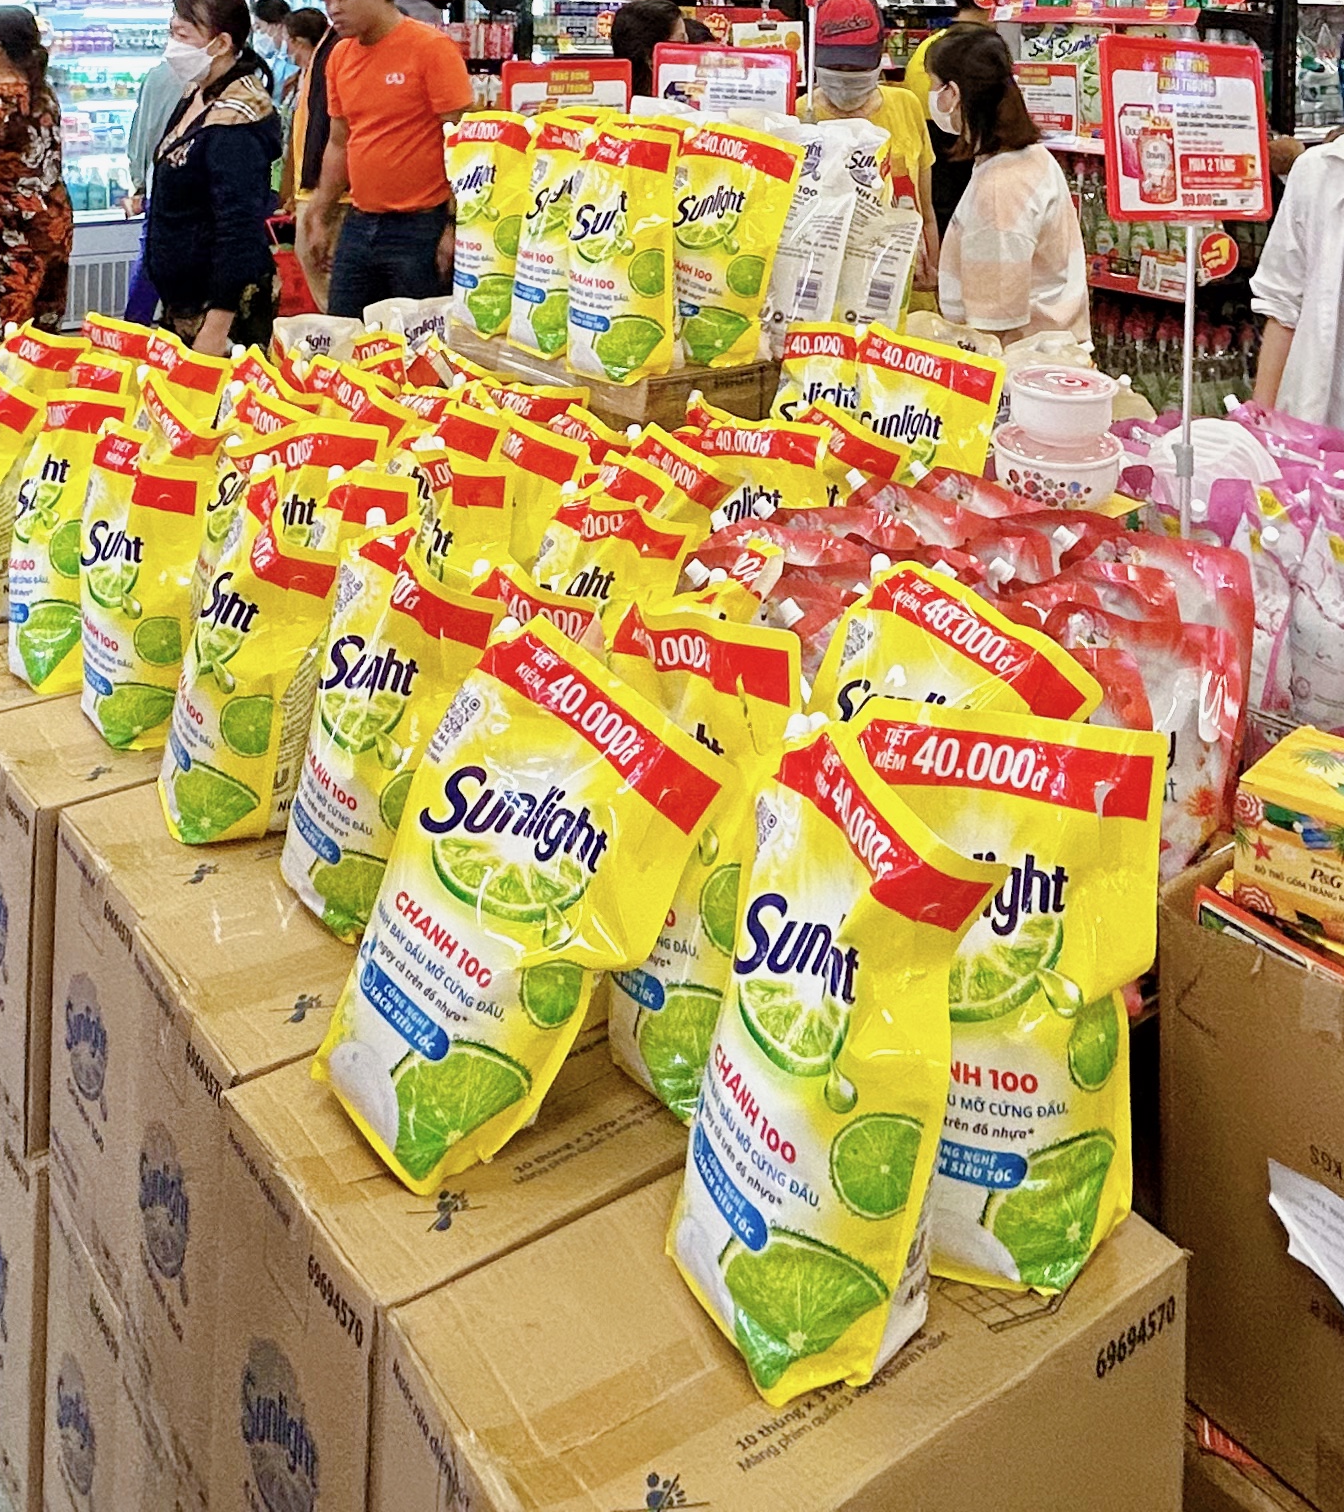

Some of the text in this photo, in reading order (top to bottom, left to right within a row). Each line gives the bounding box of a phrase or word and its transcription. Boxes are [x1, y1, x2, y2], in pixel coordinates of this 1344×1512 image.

[672, 184, 747, 229] Sunlight
[535, 252, 554, 265] 100
[594, 279, 616, 291] 100
[693, 267, 714, 282] 100
[892, 587, 923, 614] KIỆM
[908, 576, 935, 601] TIẾT
[920, 594, 1015, 673] 40.000đ
[514, 661, 546, 693] KIỆM
[547, 672, 642, 766] 40.000đ
[873, 745, 908, 775] KIỆM
[910, 731, 1050, 792] 40.000đ
[332, 782, 359, 812] 100
[419, 764, 612, 875] Sunlight
[1309, 866, 1344, 891] P&G
[395, 890, 494, 989] CHANH 100
[404, 968, 424, 991] trên
[443, 975, 479, 1009] CỨNG
[987, 1068, 1039, 1095] 100
[713, 1043, 798, 1165] CHANH 100
[960, 1095, 986, 1113] MỠ
[988, 1100, 1034, 1119] CỨNG
[943, 1115, 970, 1132] trên
[972, 1122, 989, 1137] đồ
[749, 1148, 788, 1188] CỨNG
[949, 1159, 983, 1179] SIÊU
[962, 1149, 999, 1170] NGHỆ
[1309, 1143, 1343, 1181] KGS
[307, 1254, 364, 1349] 69694570
[1094, 1294, 1178, 1381] 69694570
[735, 1433, 758, 1453] 10
